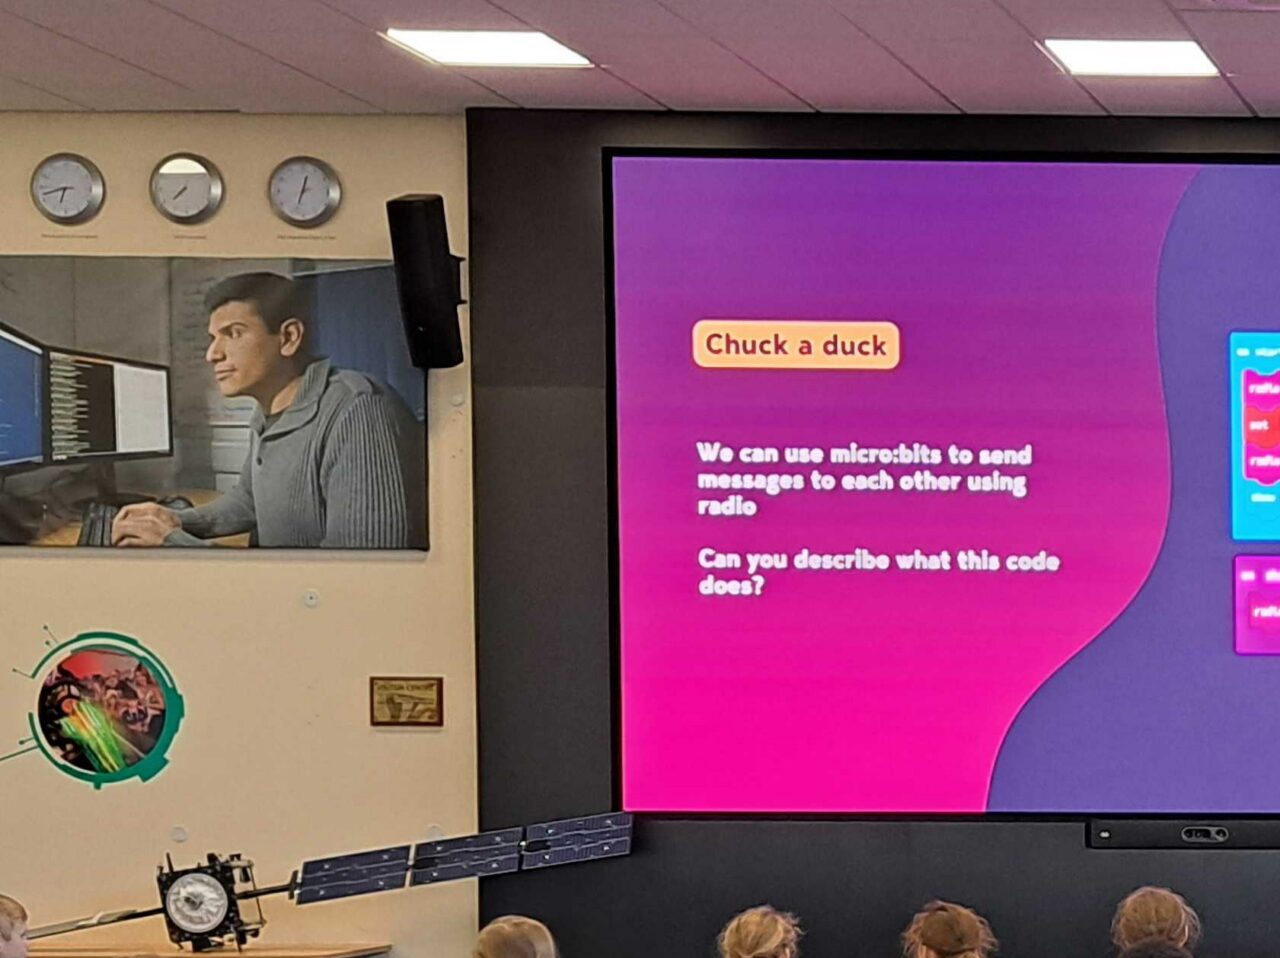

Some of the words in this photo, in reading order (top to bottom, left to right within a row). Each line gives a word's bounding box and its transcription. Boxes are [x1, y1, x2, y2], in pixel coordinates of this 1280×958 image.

[706, 333, 787, 356] Chuck
[798, 338, 813, 356] a
[823, 334, 887, 356] duck
[1249, 383, 1280, 395] radio
[697, 442, 734, 464] We
[739, 446, 779, 464] can
[785, 447, 824, 464] use
[830, 442, 942, 465] micro:bits
[948, 444, 973, 464] to
[979, 444, 1032, 465] send
[697, 473, 804, 495] messages
[811, 471, 836, 491] to
[841, 470, 894, 491] each
[899, 471, 961, 491] other
[967, 471, 1028, 498] using
[697, 496, 757, 516] radio
[698, 548, 741, 570] Can
[746, 552, 787, 574] you
[794, 549, 890, 571] describe
[896, 549, 951, 571] what
[957, 549, 1000, 571] this
[1006, 550, 1061, 572] code
[698, 575, 765, 596] does?
